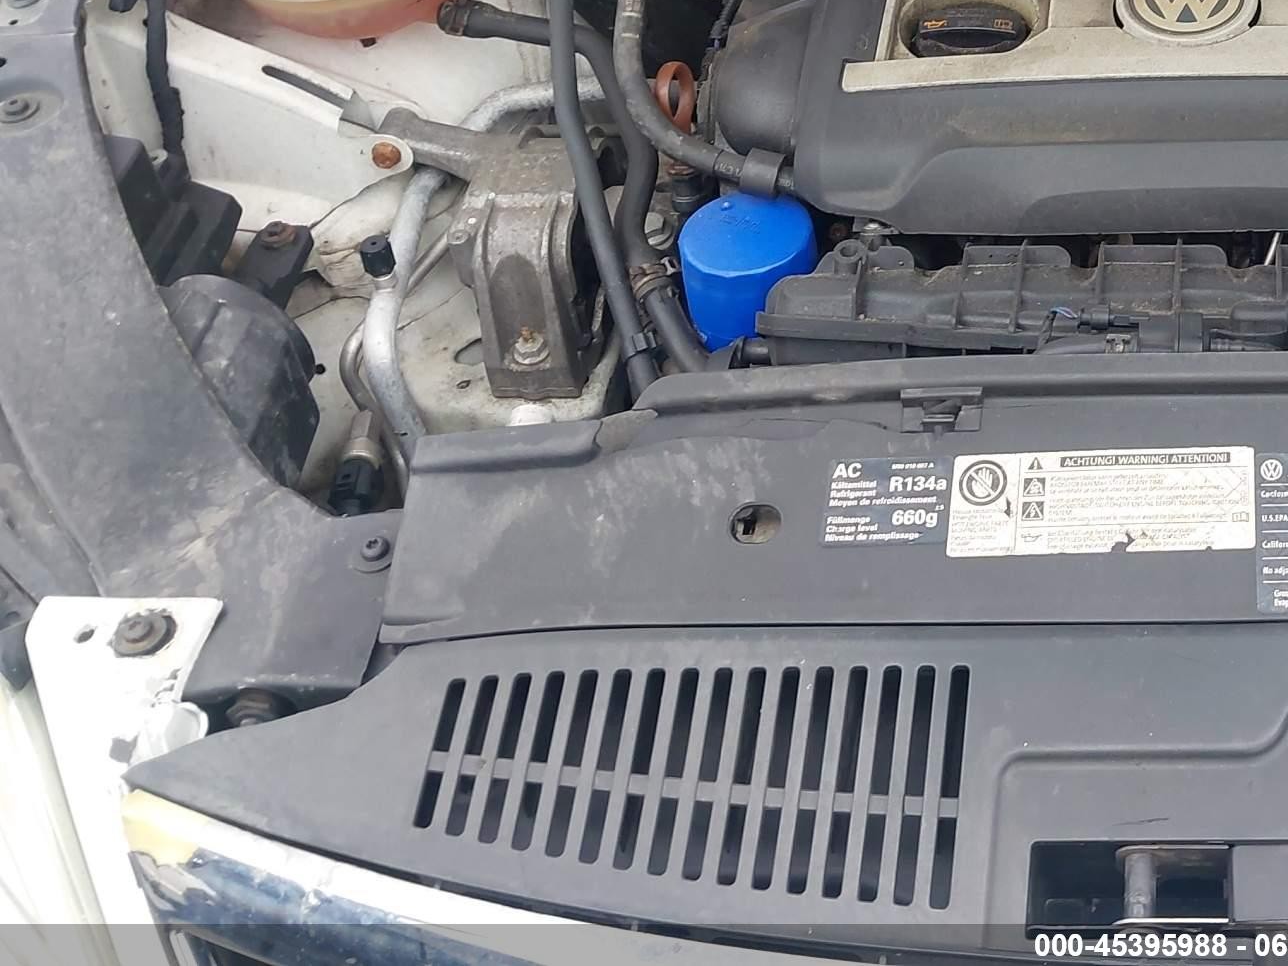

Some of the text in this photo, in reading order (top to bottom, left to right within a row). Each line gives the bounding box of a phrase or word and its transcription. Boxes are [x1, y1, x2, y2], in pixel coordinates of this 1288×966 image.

[832, 462, 862, 479] AC
[889, 475, 948, 492] R134a
[830, 490, 877, 499] Refrigerant
[829, 496, 938, 507] Moyen de refroidissement
[826, 516, 871, 525] Füllmenge
[891, 509, 938, 527] 660g
[826, 523, 878, 534] Charge level
[825, 532, 920, 542] Niveau de remplissage
[1262, 565, 1273, 574] No
